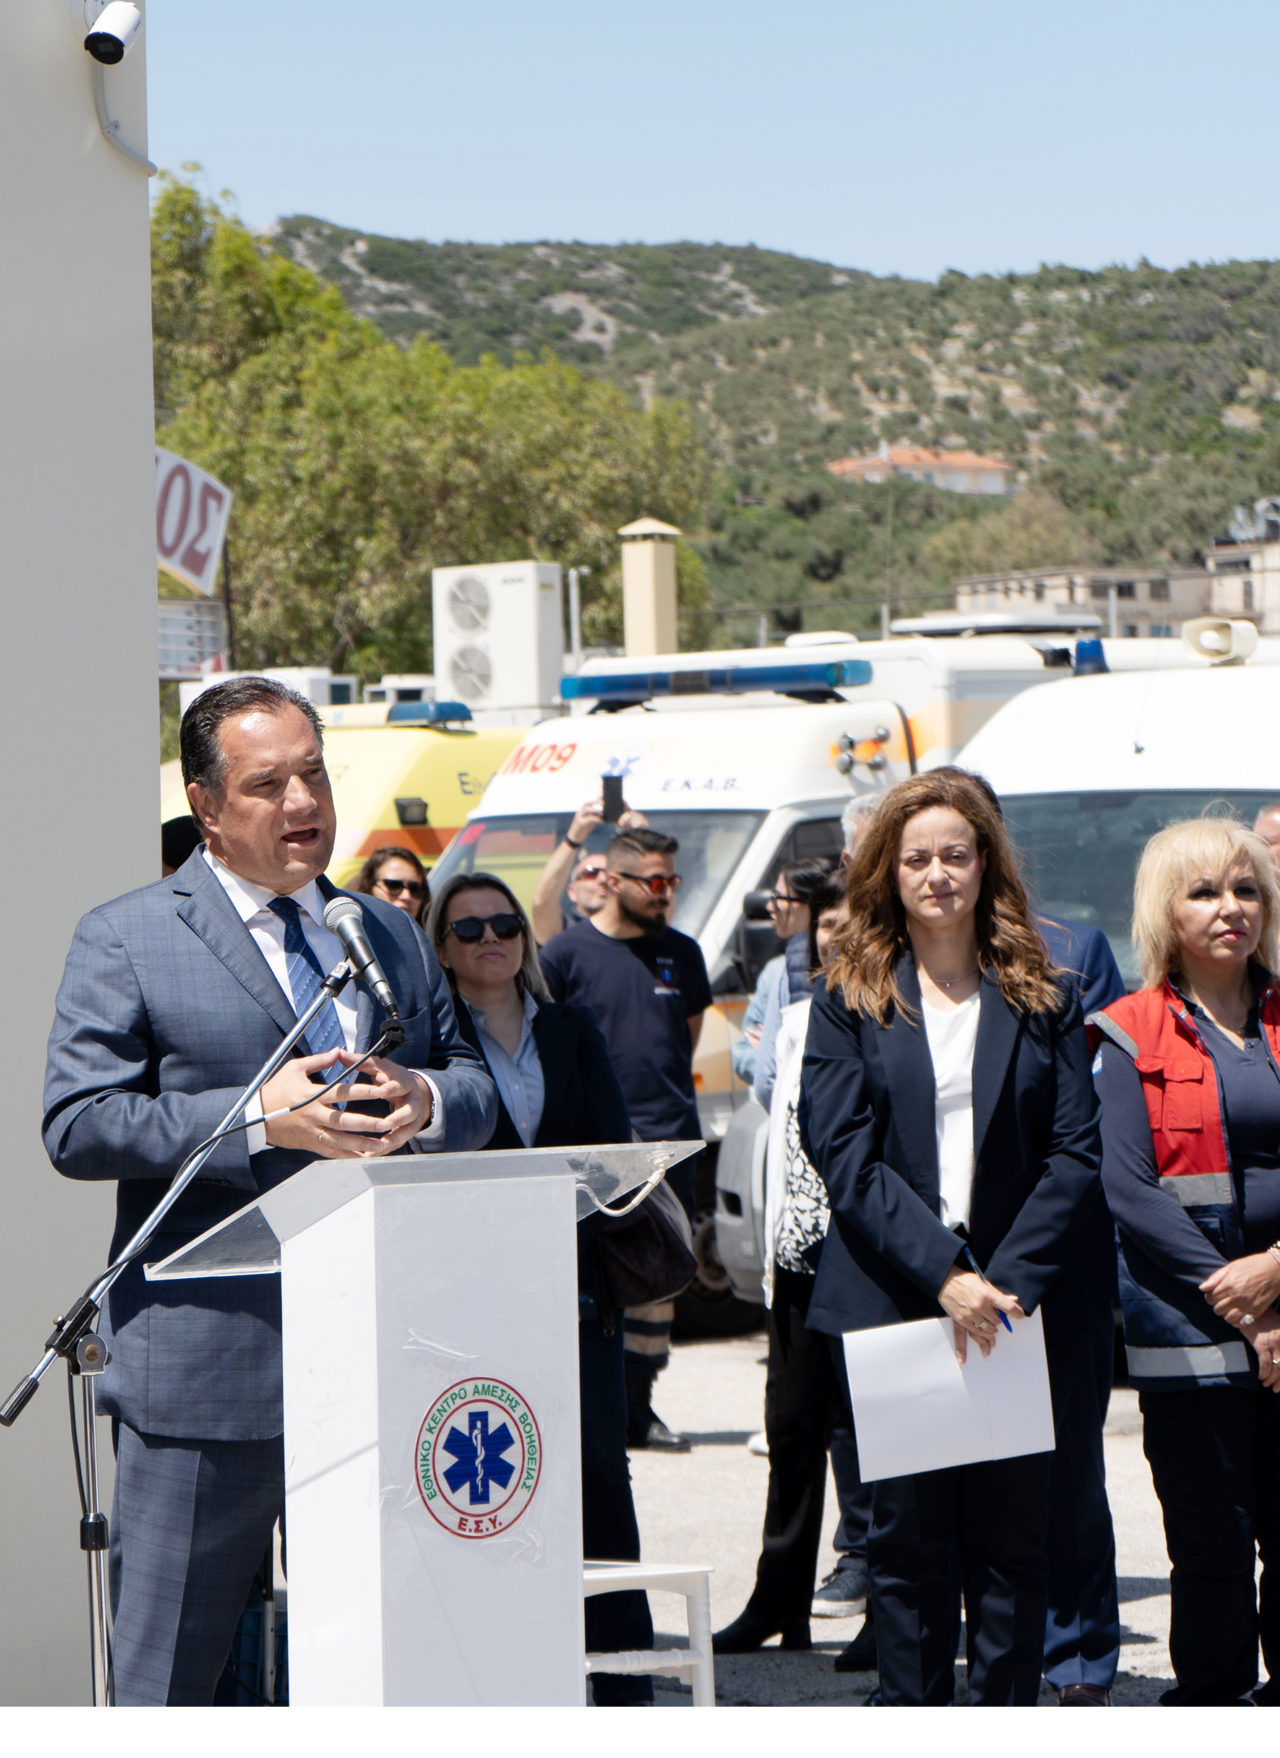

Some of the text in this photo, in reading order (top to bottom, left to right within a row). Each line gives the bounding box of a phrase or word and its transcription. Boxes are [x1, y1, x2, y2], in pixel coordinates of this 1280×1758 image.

[420, 1383, 538, 1501] ΕΘΝΙΚΟ ΚΕΝΤΡΟ ΑΜΕΣΗΣ ΒΟΗΘΕΙΑΣ
[457, 1514, 503, 1533] Ε.Σ.Υ.
